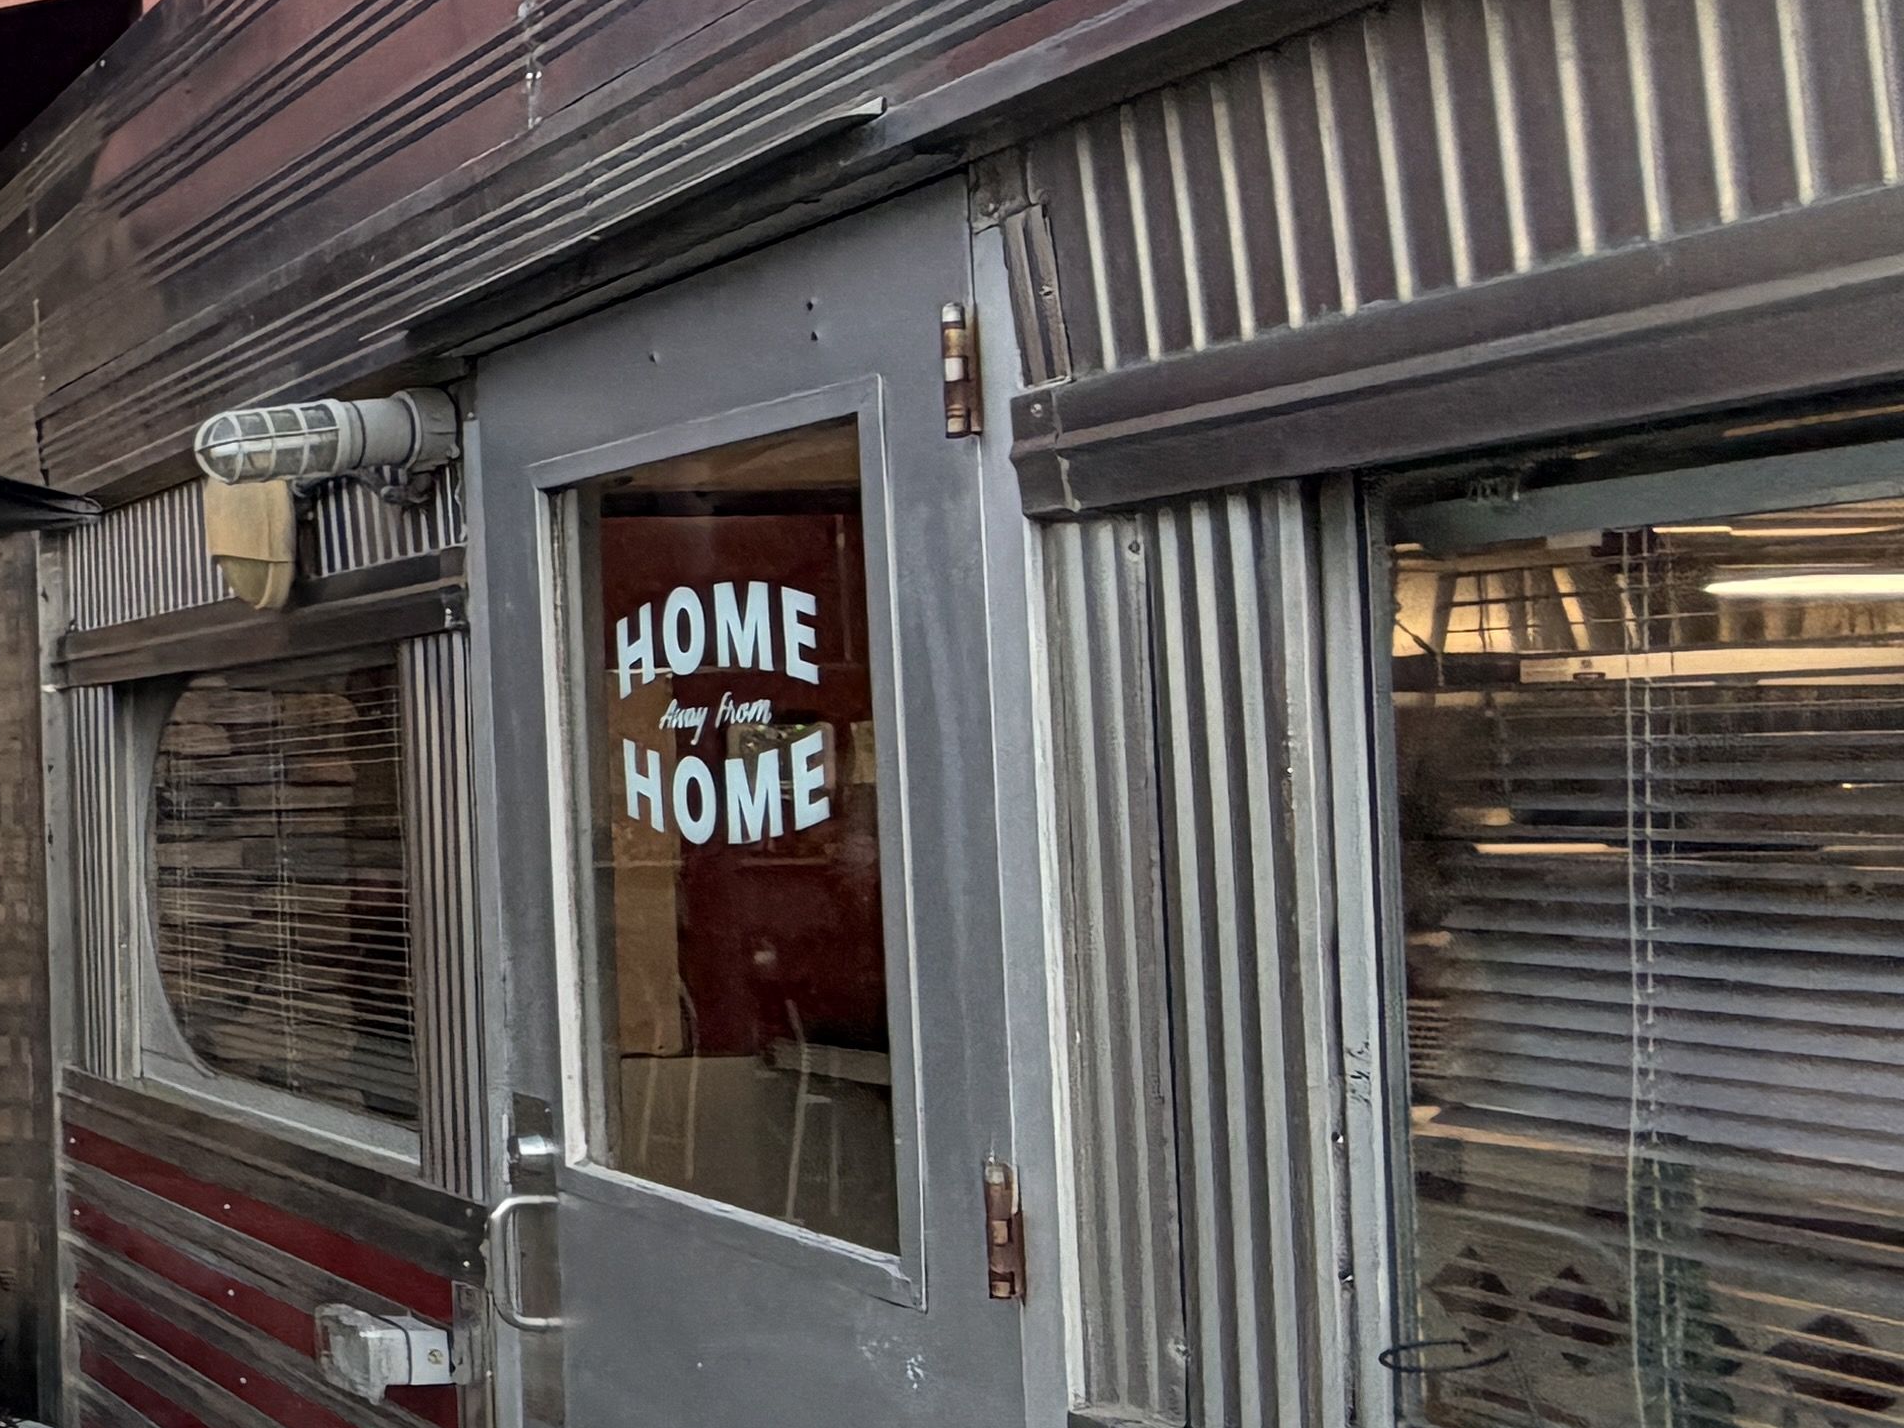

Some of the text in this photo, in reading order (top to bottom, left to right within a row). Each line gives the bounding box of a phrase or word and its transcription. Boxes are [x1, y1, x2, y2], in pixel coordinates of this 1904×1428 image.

[615, 580, 820, 700] HOME
[658, 690, 773, 745] Away from
[622, 730, 831, 846] HOME
